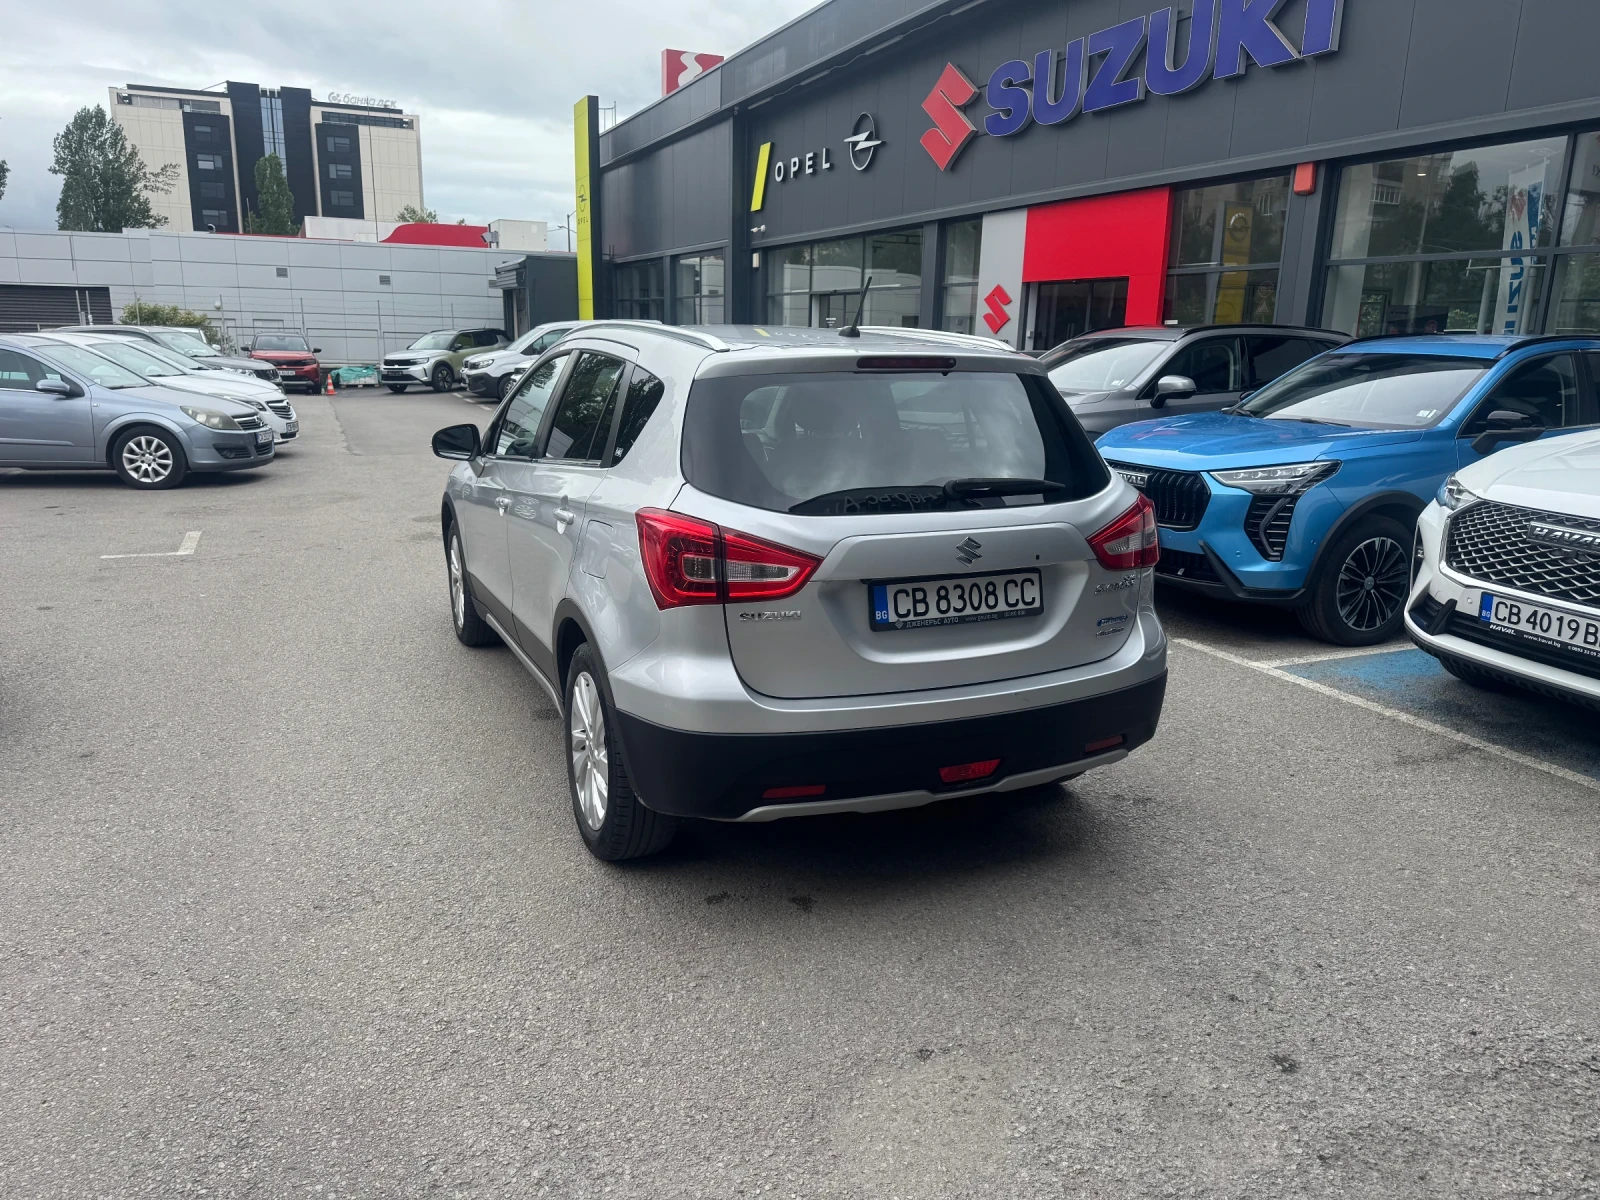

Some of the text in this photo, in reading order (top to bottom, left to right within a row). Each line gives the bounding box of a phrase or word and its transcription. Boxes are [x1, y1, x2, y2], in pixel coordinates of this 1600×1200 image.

[984, 0, 1341, 137] SUZUKI
[774, 147, 831, 182] OPEL
[739, 610, 801, 621] SUZUKI
[875, 610, 888, 620] BG
[936, 580, 999, 614] 8308
[1481, 610, 1491, 618] BG
[1525, 609, 1580, 641] 4019
[1583, 622, 1600, 647] B
[1489, 624, 1517, 636] HAVAL
